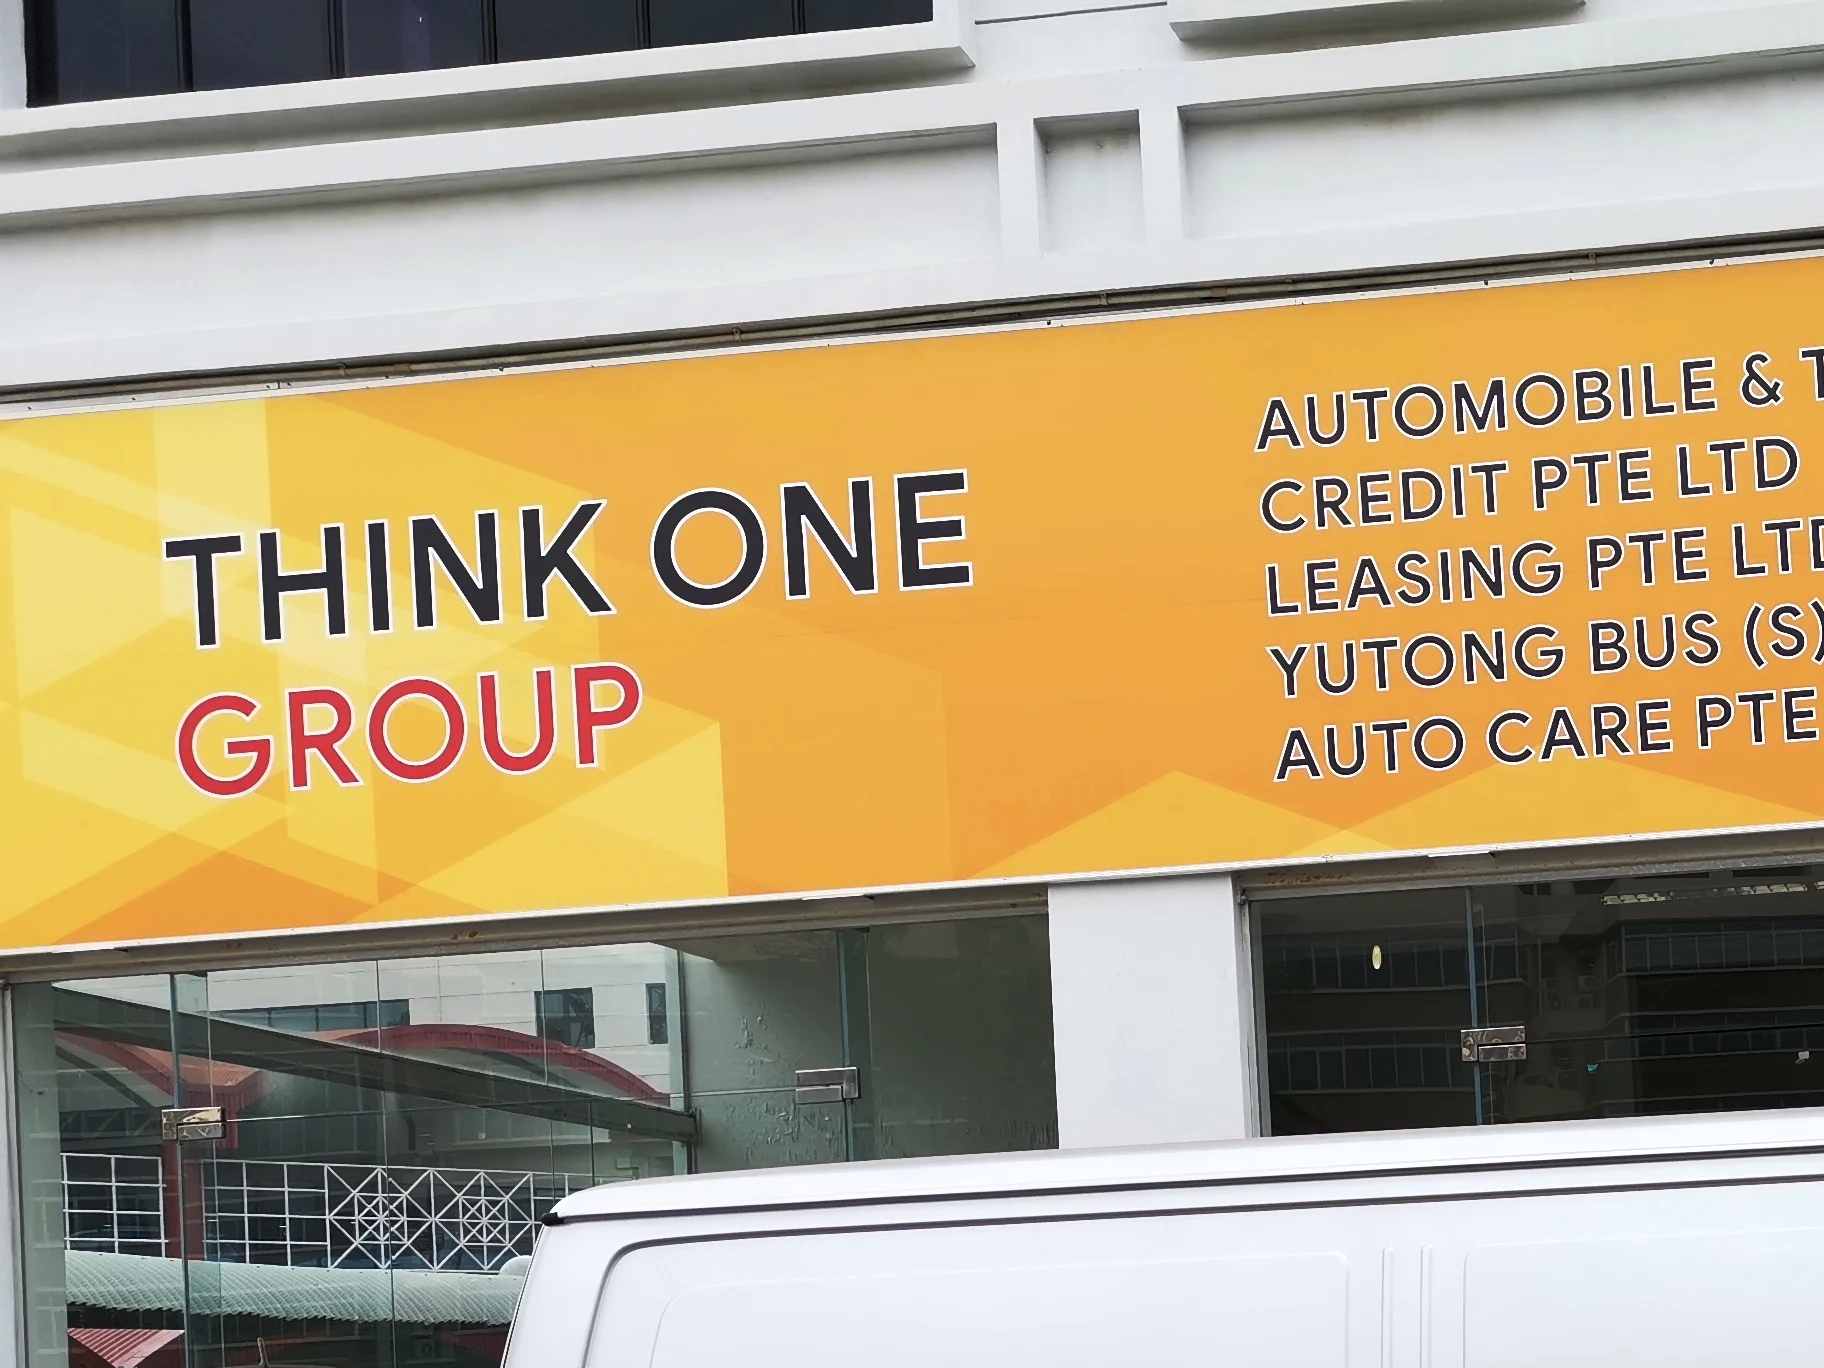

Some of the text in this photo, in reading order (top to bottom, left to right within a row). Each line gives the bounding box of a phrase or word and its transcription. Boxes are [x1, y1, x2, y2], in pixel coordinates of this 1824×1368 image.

[1254, 357, 1718, 452] AUTOMOBILE
[1739, 351, 1783, 408] &
[1259, 436, 1800, 534] CREDIT PTE LTD
[162, 469, 973, 649] THINK ONE
[1265, 540, 1564, 617] LEASING
[1586, 527, 1709, 591] PTE
[1267, 624, 1566, 698] YUTONG
[1588, 611, 1721, 674] BUS
[174, 663, 644, 800] GROUP
[1274, 716, 1466, 782] AUTO
[1486, 698, 1673, 765] CARE
[1696, 687, 1819, 749] PTE
